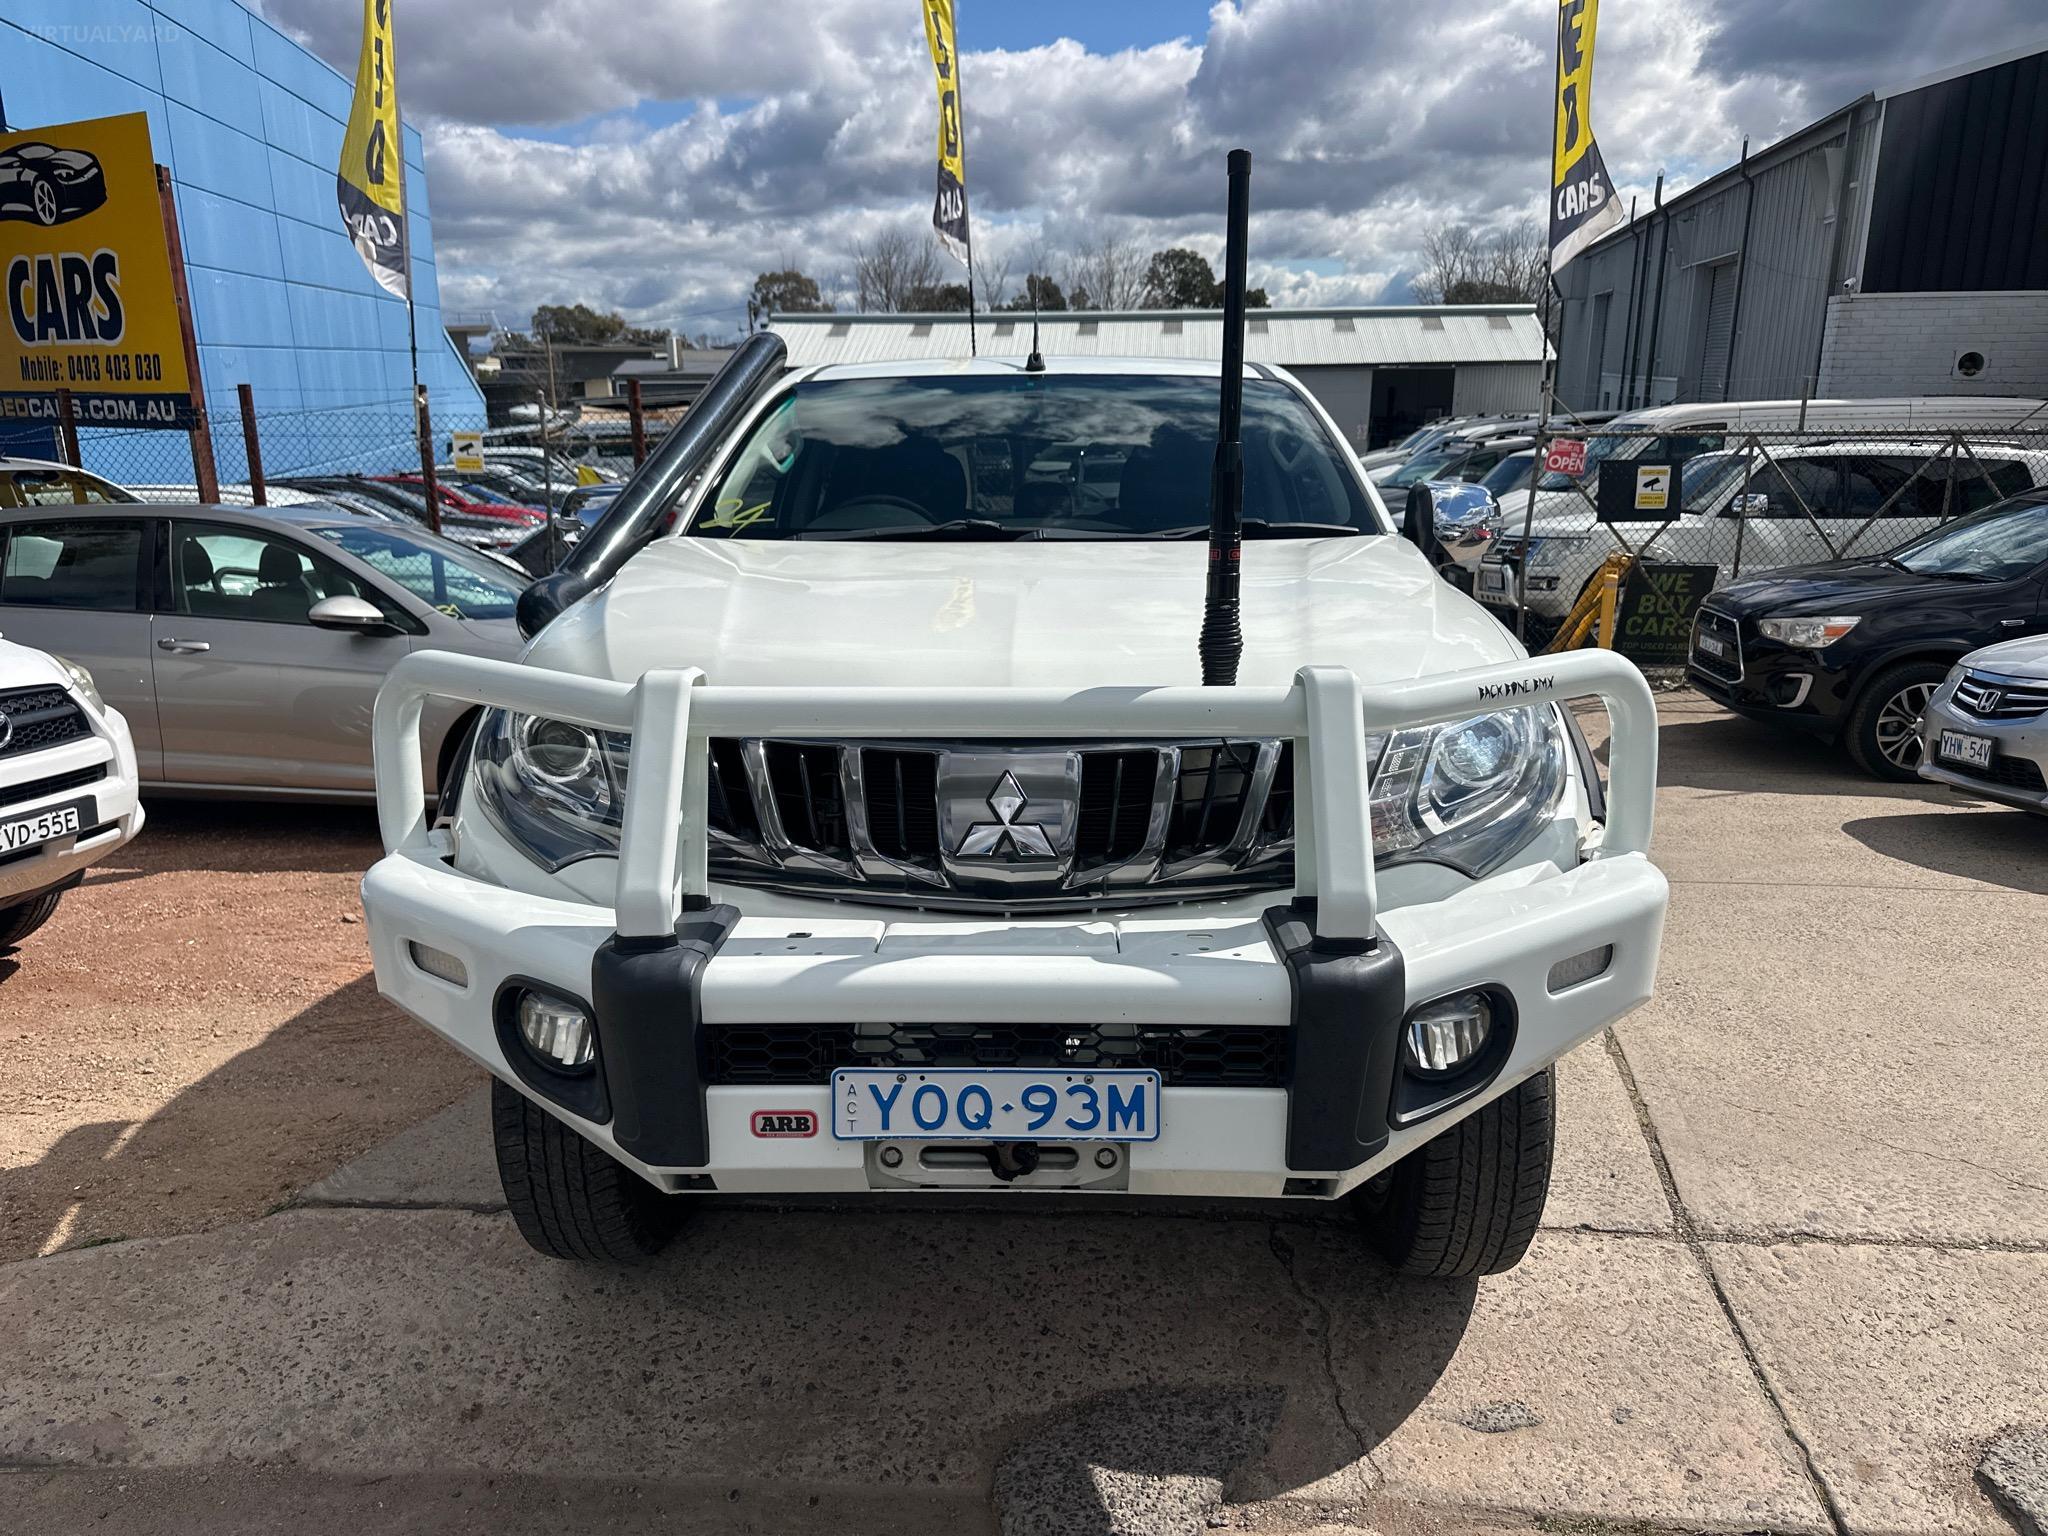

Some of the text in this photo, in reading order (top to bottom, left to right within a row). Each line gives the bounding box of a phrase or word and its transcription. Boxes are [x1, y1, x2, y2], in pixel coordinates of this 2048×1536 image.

[1557, 172, 1606, 221] CARS
[7, 248, 125, 347] CARS
[20, 353, 162, 382] Mobile: 0403 403 030
[0, 398, 177, 422] EDCAS.COM.AU
[1548, 455, 1585, 471] OPEN
[1652, 572, 1694, 593] WE
[1637, 593, 1693, 615] BUY
[1624, 616, 1693, 637] CARS
[1533, 675, 1554, 692] BMX
[760, 1116, 810, 1132] ARB
